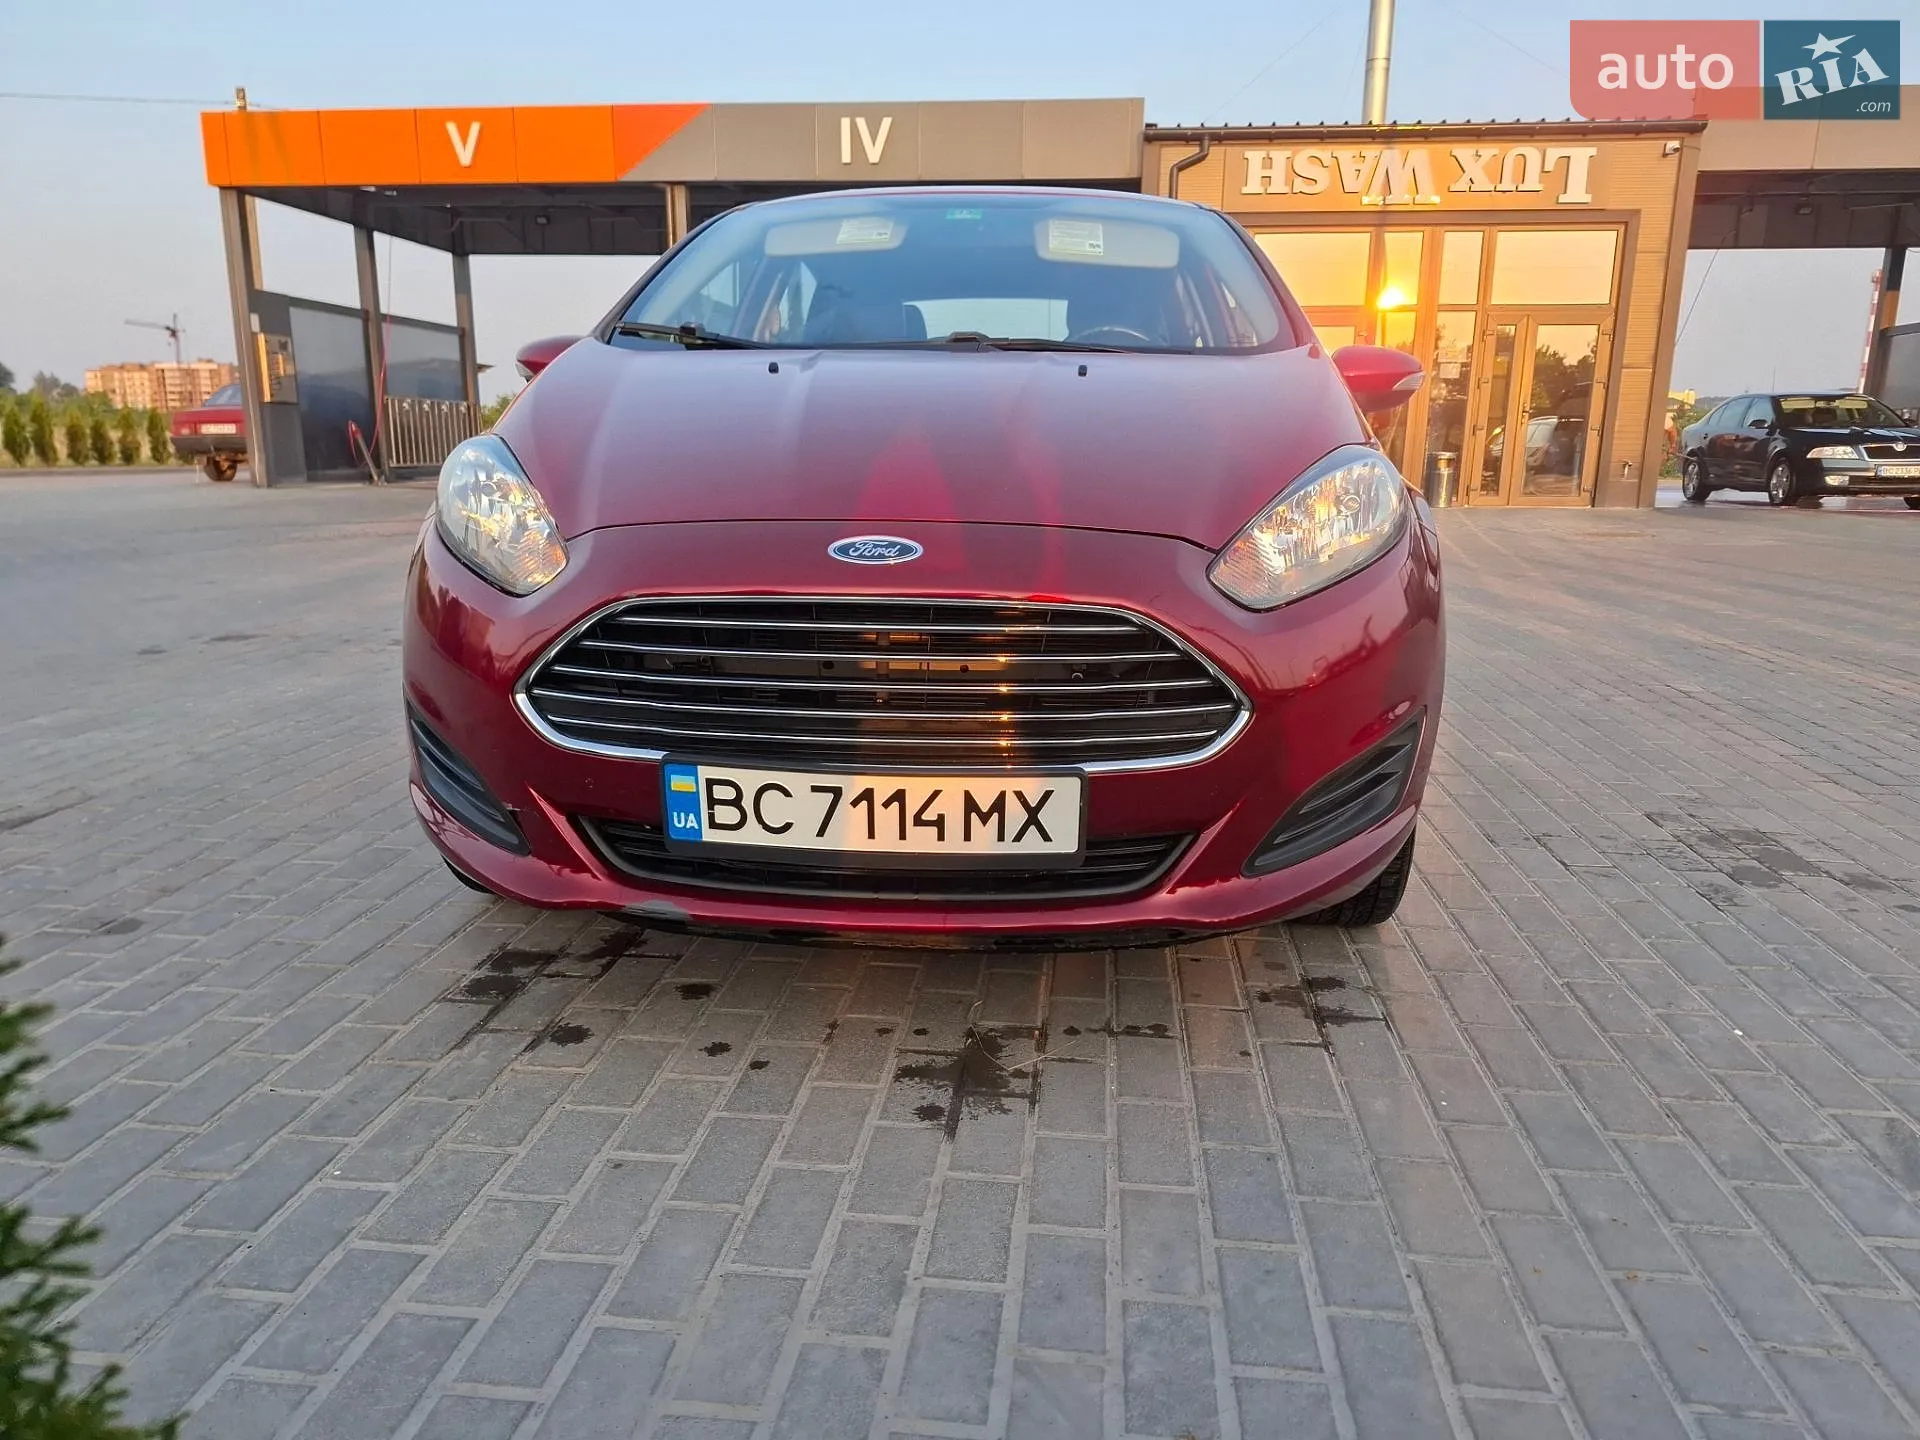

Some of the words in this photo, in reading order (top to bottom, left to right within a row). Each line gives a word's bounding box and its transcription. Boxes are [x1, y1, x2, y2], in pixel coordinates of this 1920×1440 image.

[445, 120, 481, 168] V
[839, 116, 893, 165] IV
[1241, 148, 1441, 206] WASH
[848, 540, 901, 557] Ford
[673, 811, 698, 829] UA
[704, 777, 794, 835] BC
[810, 784, 946, 843] 7114
[962, 788, 1055, 844] MX
